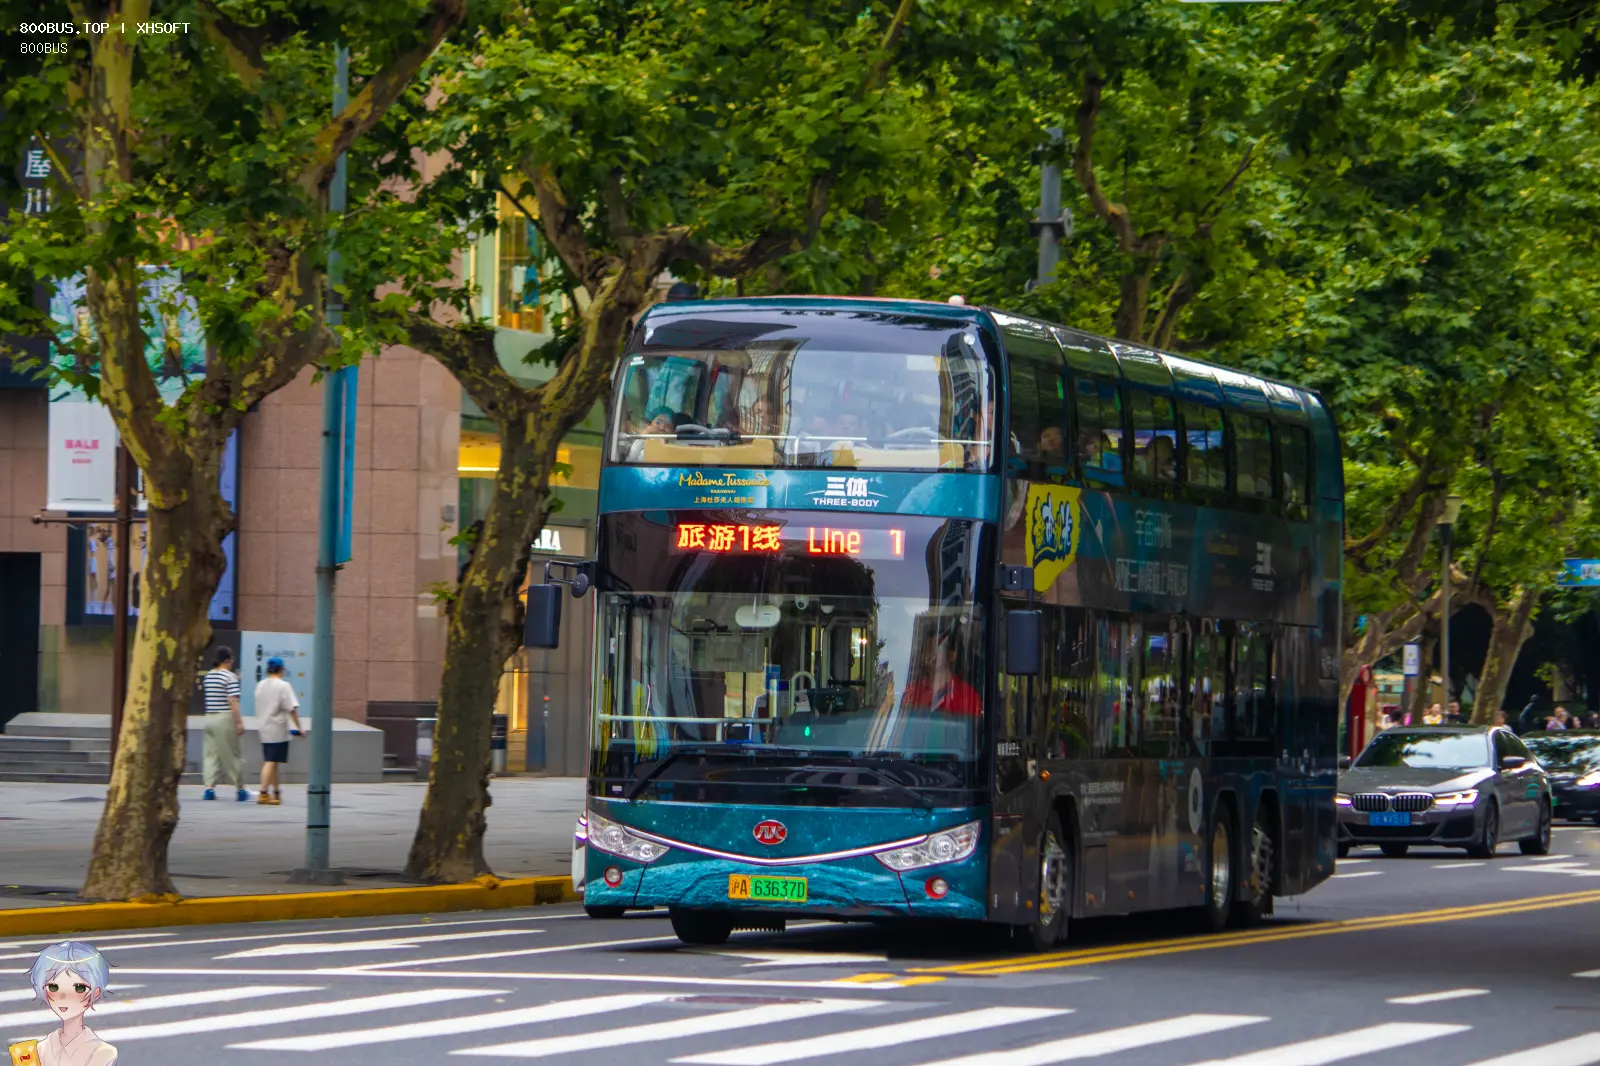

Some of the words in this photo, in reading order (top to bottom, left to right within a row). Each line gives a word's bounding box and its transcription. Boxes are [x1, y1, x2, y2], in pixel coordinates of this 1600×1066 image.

[678, 471, 723, 487] Madame
[722, 472, 770, 487] Tussauds
[824, 476, 869, 497] 三体
[813, 497, 880, 508] THREE-BODY
[677, 524, 781, 551] 旅游1线
[890, 529, 902, 554] 1
